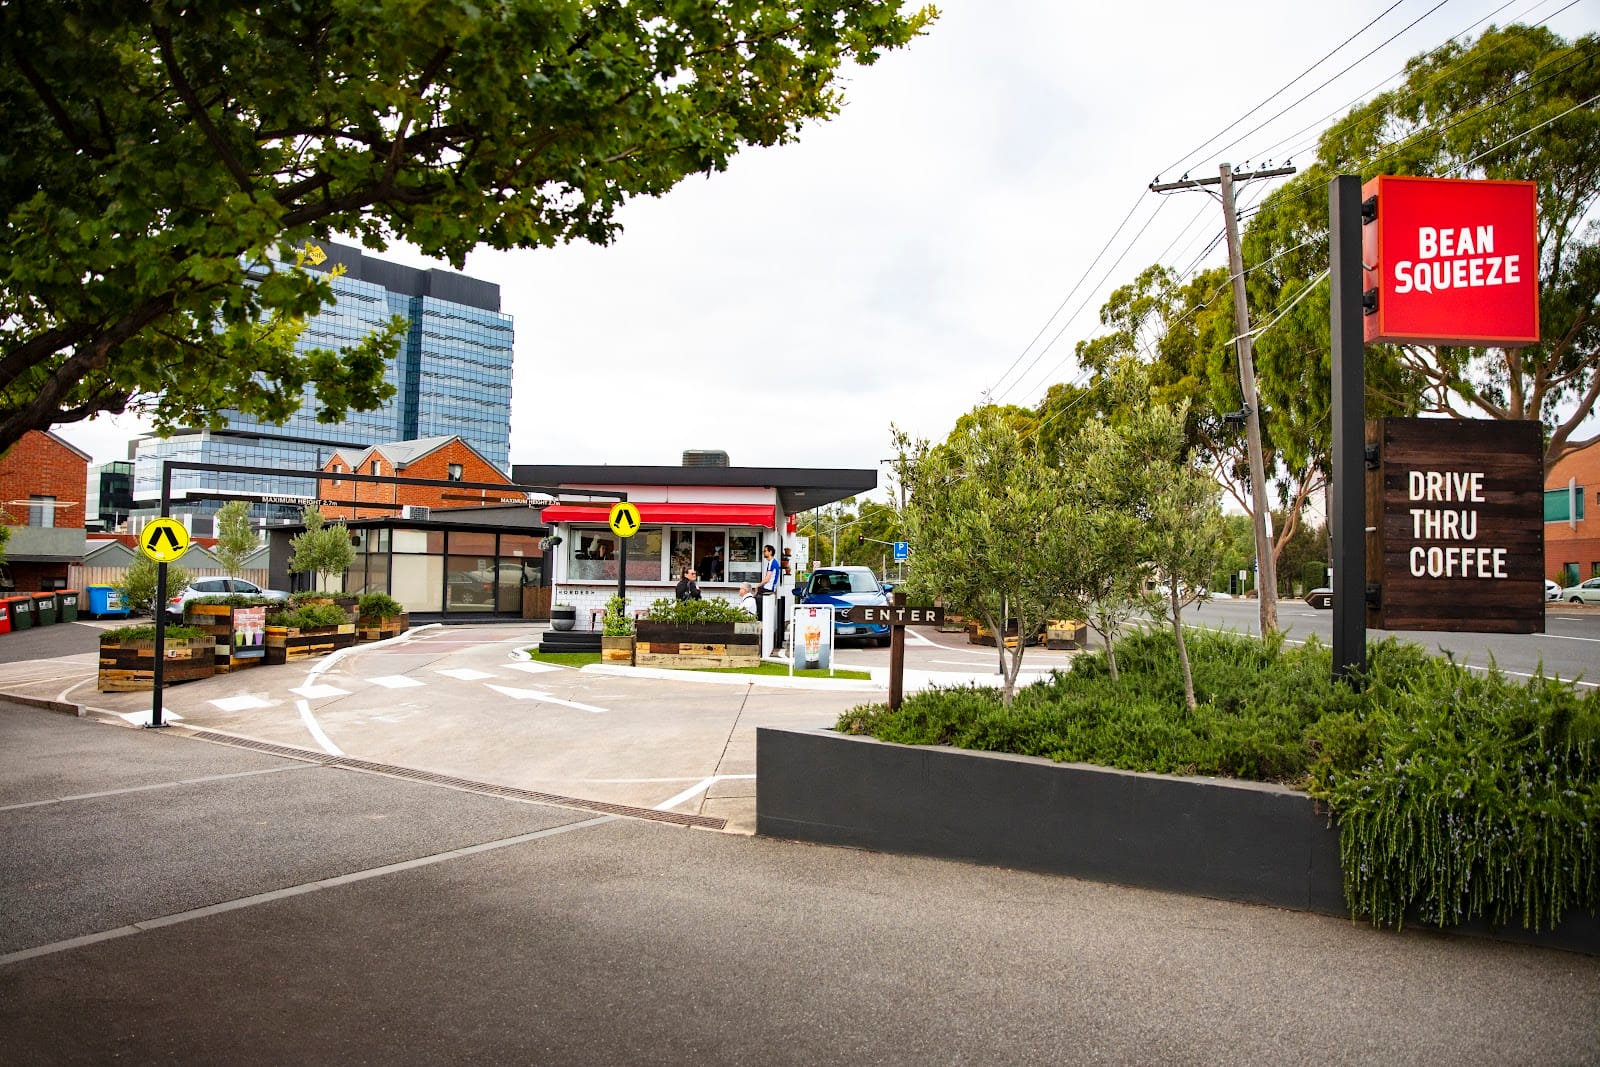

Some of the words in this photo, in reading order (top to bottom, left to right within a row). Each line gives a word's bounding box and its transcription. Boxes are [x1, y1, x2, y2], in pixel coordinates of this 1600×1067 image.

[1418, 225, 1494, 260] BEAN
[1394, 255, 1521, 294] SQUEEZE
[262, 496, 297, 505] MAXIMUM
[1408, 470, 1486, 503] DRIVE
[1410, 508, 1478, 541] THRU
[1409, 546, 1508, 579] COFFEE
[865, 609, 936, 622] ENTER
